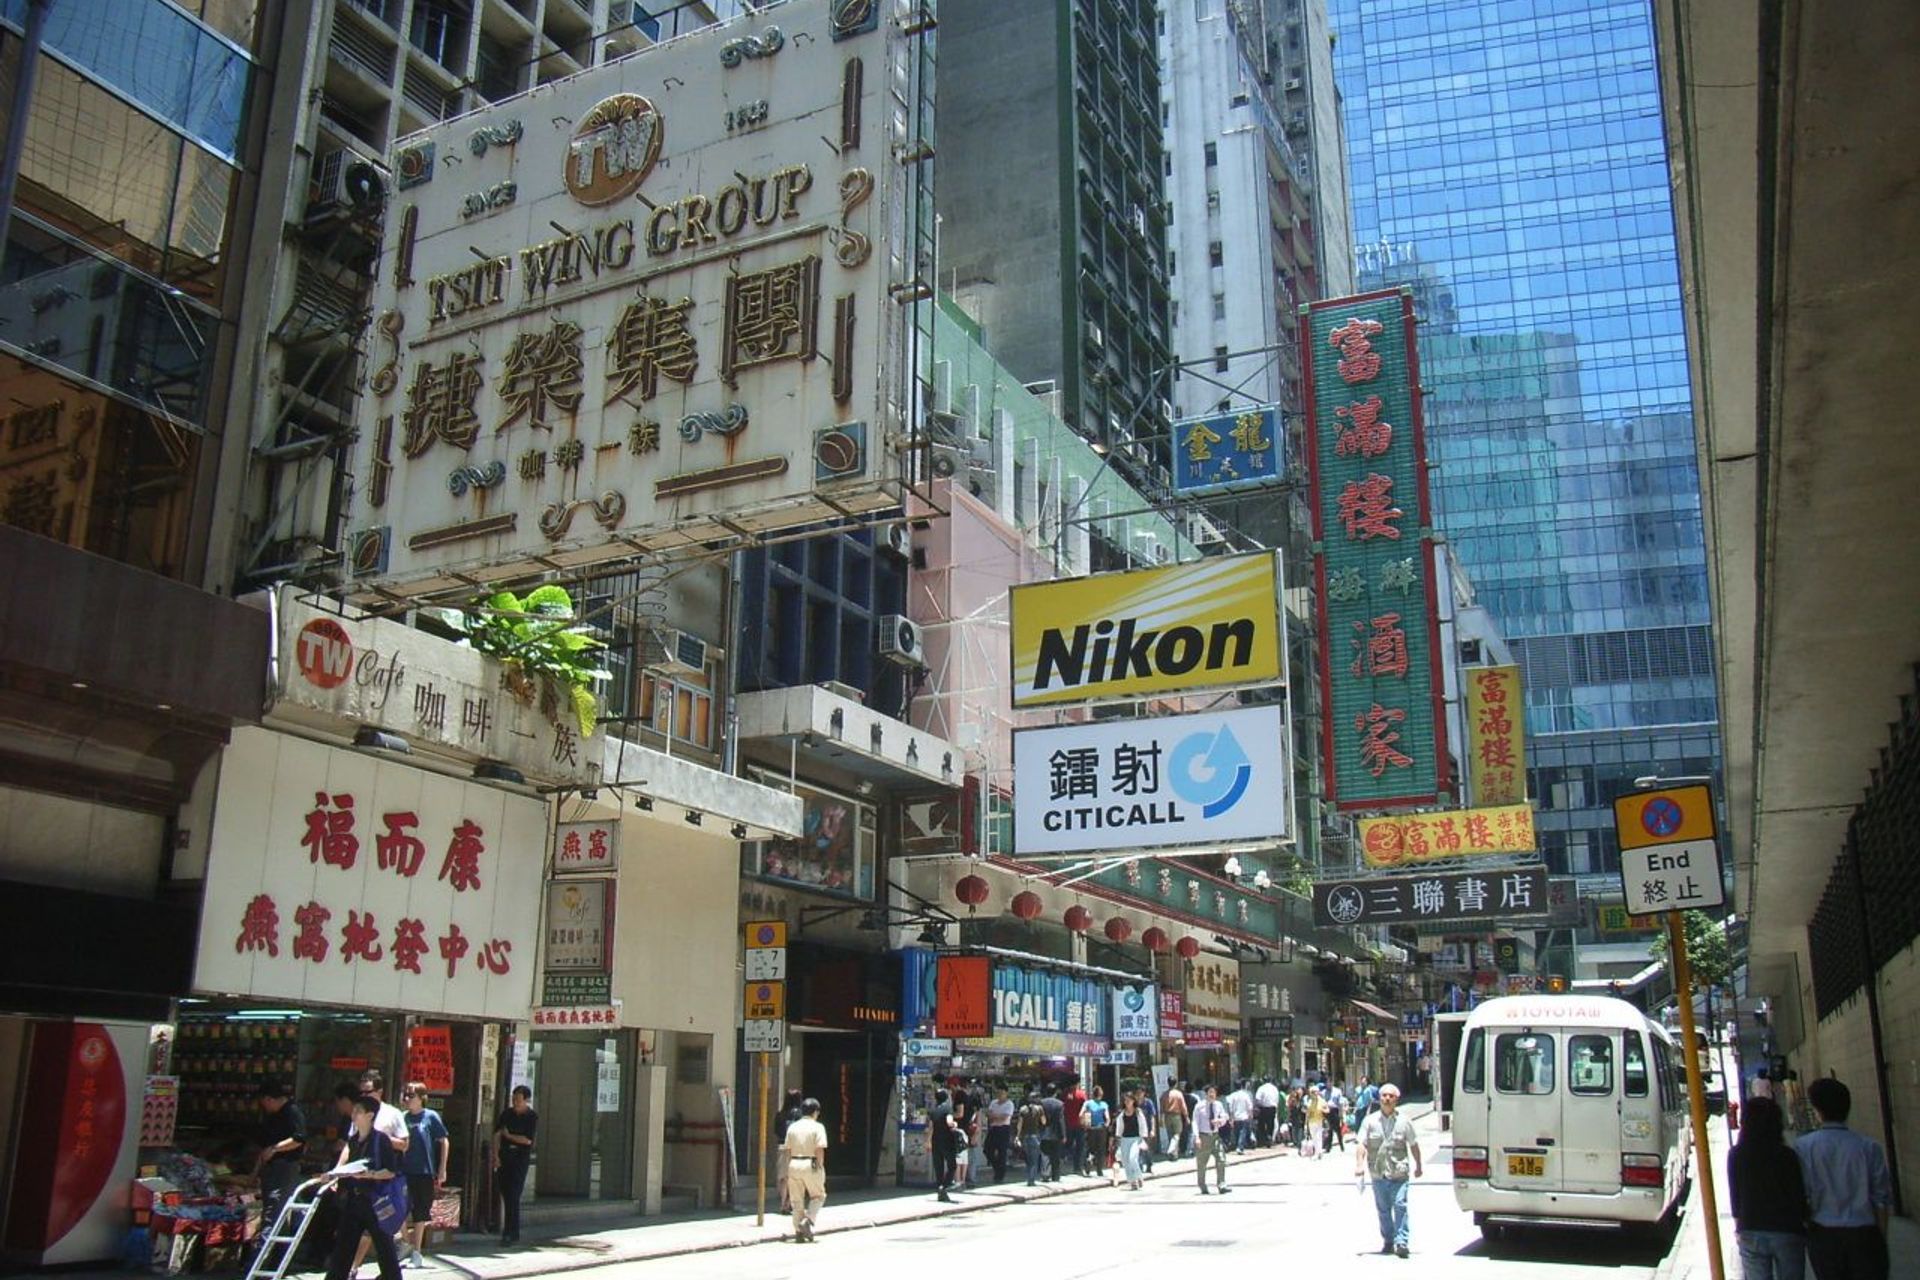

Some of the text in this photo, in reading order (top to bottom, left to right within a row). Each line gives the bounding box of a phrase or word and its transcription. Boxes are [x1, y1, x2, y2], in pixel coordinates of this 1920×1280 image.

[427, 163, 813, 325] TSIT WING GROUP
[403, 253, 823, 459] 捷榮集團
[517, 417, 661, 481] 咖啡一族
[1181, 413, 1270, 462] 金龍
[1329, 317, 1404, 540] 富滿樓
[301, 630, 406, 709] TW Café
[1032, 617, 1255, 690] Nikon
[1350, 612, 1415, 778] 酒家
[414, 681, 579, 768] 咖啡一族
[1475, 670, 1516, 769] 富滿樓
[1049, 740, 1162, 802] 鐳射
[1043, 802, 1185, 832] CITICALL
[1402, 813, 1495, 857] 富滿樓
[301, 791, 485, 892] 福而康
[560, 829, 609, 862] 燕窩
[1647, 850, 1690, 872] End
[1369, 874, 1532, 915] 三聯書店
[1642, 876, 1703, 905] 終止
[236, 894, 513, 979] 燕窩批發中心
[771, 950, 778, 961] 7
[771, 966, 778, 977] 7
[1116, 1030, 1153, 1038] CITICALL
[1120, 1014, 1150, 1030] 鐳射
[1522, 1006, 1586, 1018] TOYOTA
[767, 1037, 780, 1049] 12
[1518, 1157, 1535, 1166] AM
